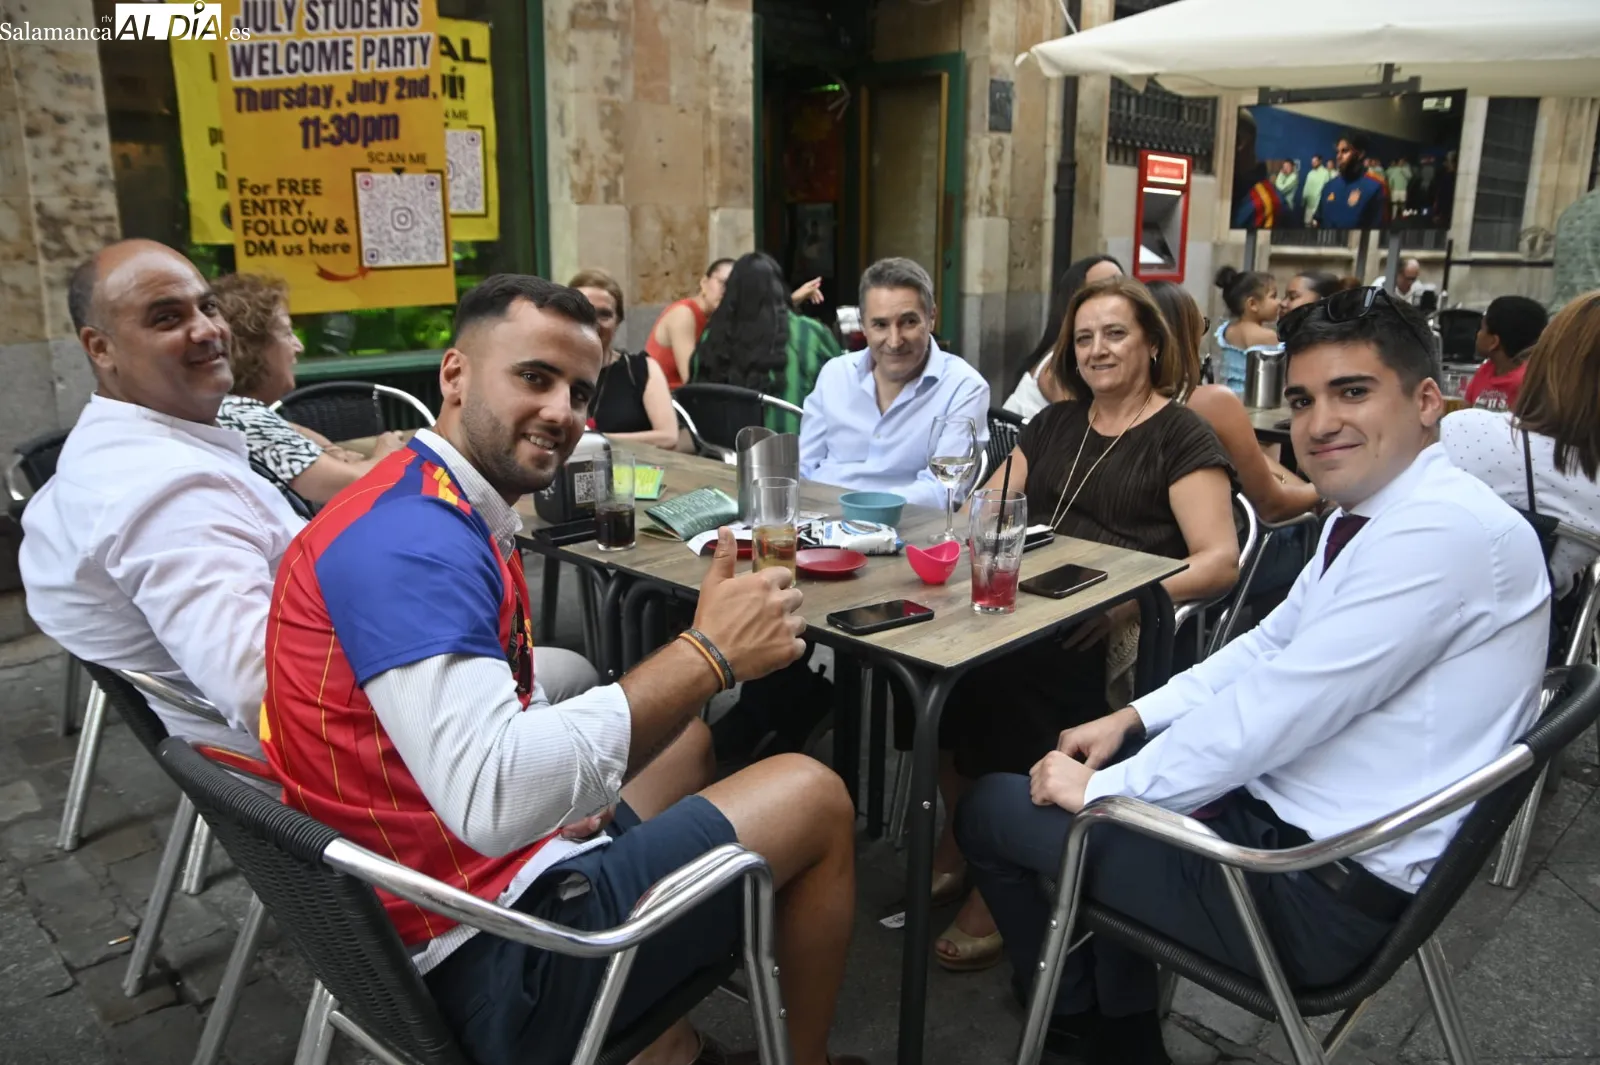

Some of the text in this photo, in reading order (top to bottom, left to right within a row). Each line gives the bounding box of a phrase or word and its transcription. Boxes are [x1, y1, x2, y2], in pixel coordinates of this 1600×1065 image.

[235, 0, 420, 33] JULY STUDENTS
[230, 39, 354, 77] WELCOME
[362, 35, 431, 70] PARTY
[347, 78, 389, 105] July
[299, 113, 399, 149] 11:30pm
[367, 152, 427, 165] SCAN ME
[237, 178, 273, 196] For
[276, 178, 322, 196] FREE
[242, 217, 349, 237] FOLLOW &
[244, 238, 350, 257] DM us here
